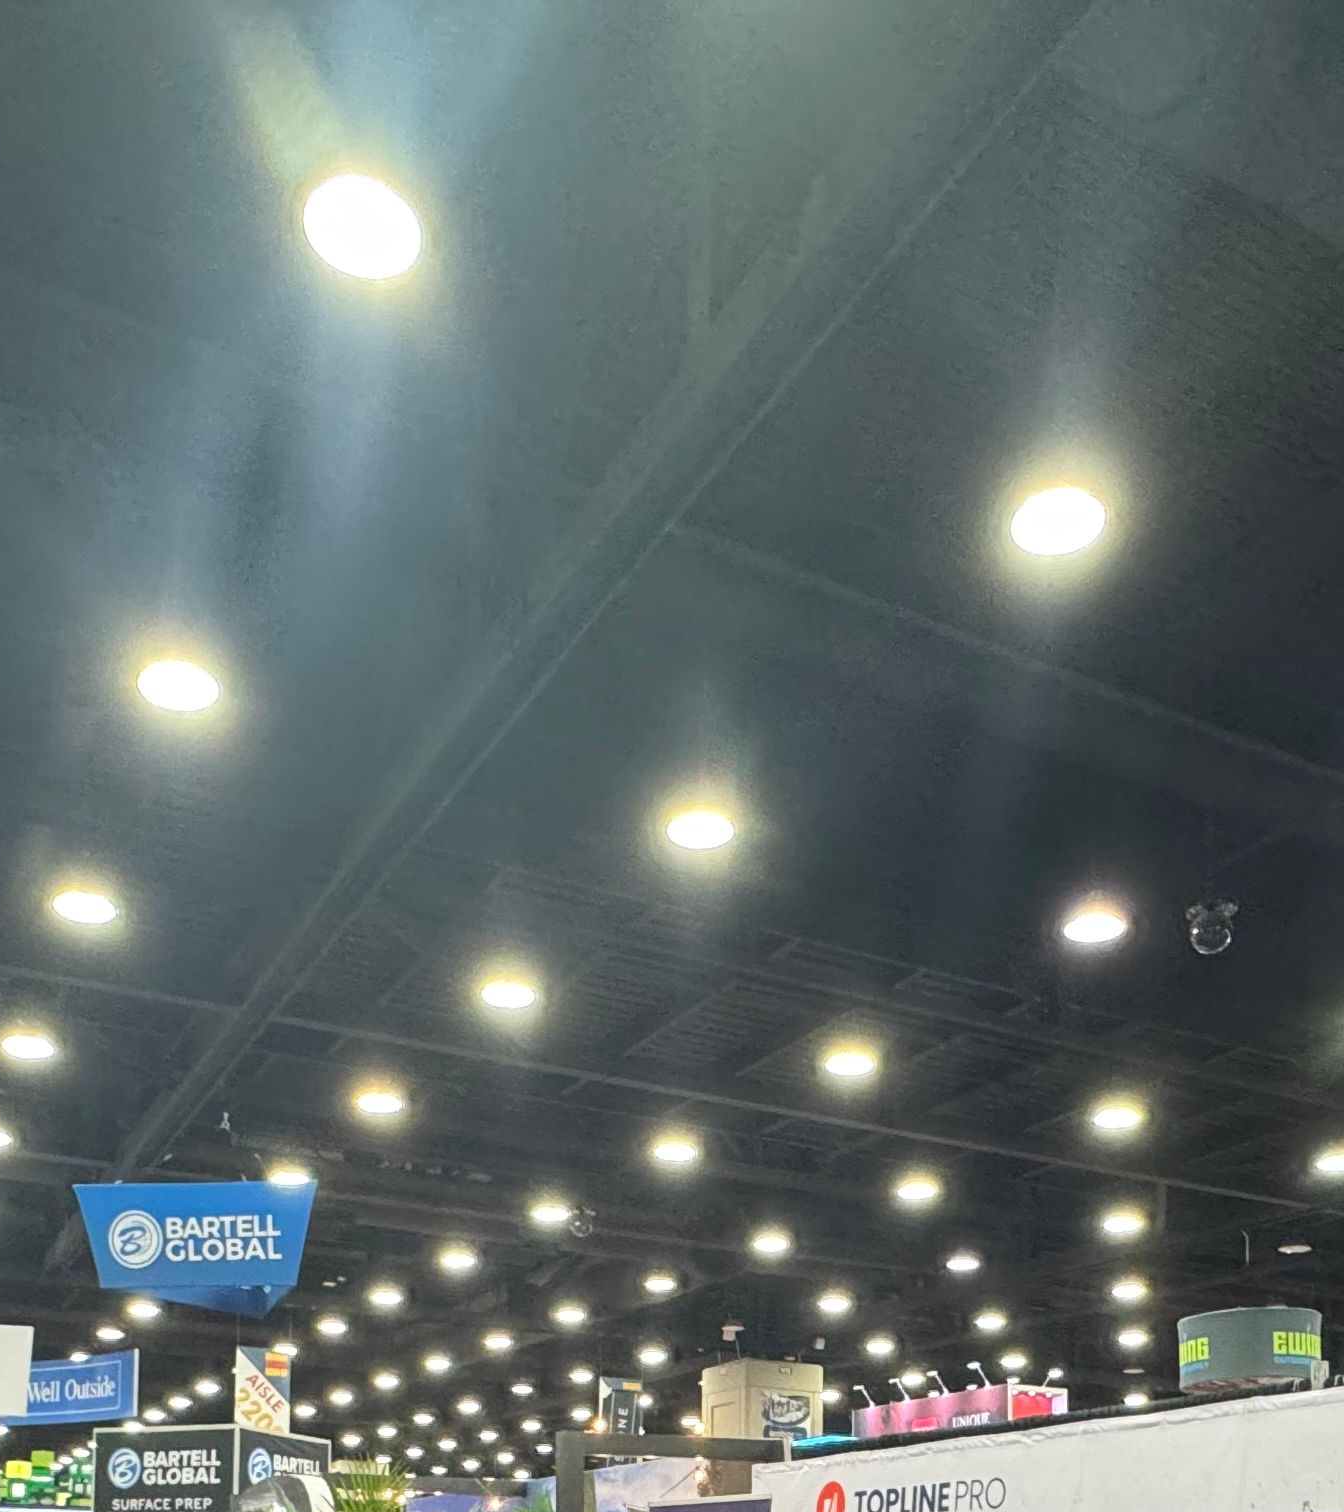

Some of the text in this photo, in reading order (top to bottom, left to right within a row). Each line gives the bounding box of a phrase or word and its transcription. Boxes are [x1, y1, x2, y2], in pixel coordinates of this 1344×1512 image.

[166, 1214, 281, 1239] BARTELL
[166, 1237, 283, 1262] GLOBAL
[65, 1375, 116, 1399] Outside
[246, 1375, 285, 1413] AISLE
[143, 1449, 222, 1469] BARTELL
[273, 1454, 323, 1476] BARTELL
[142, 1467, 221, 1485] GLOBAL
[111, 1497, 213, 1511] SURFACE PREP
